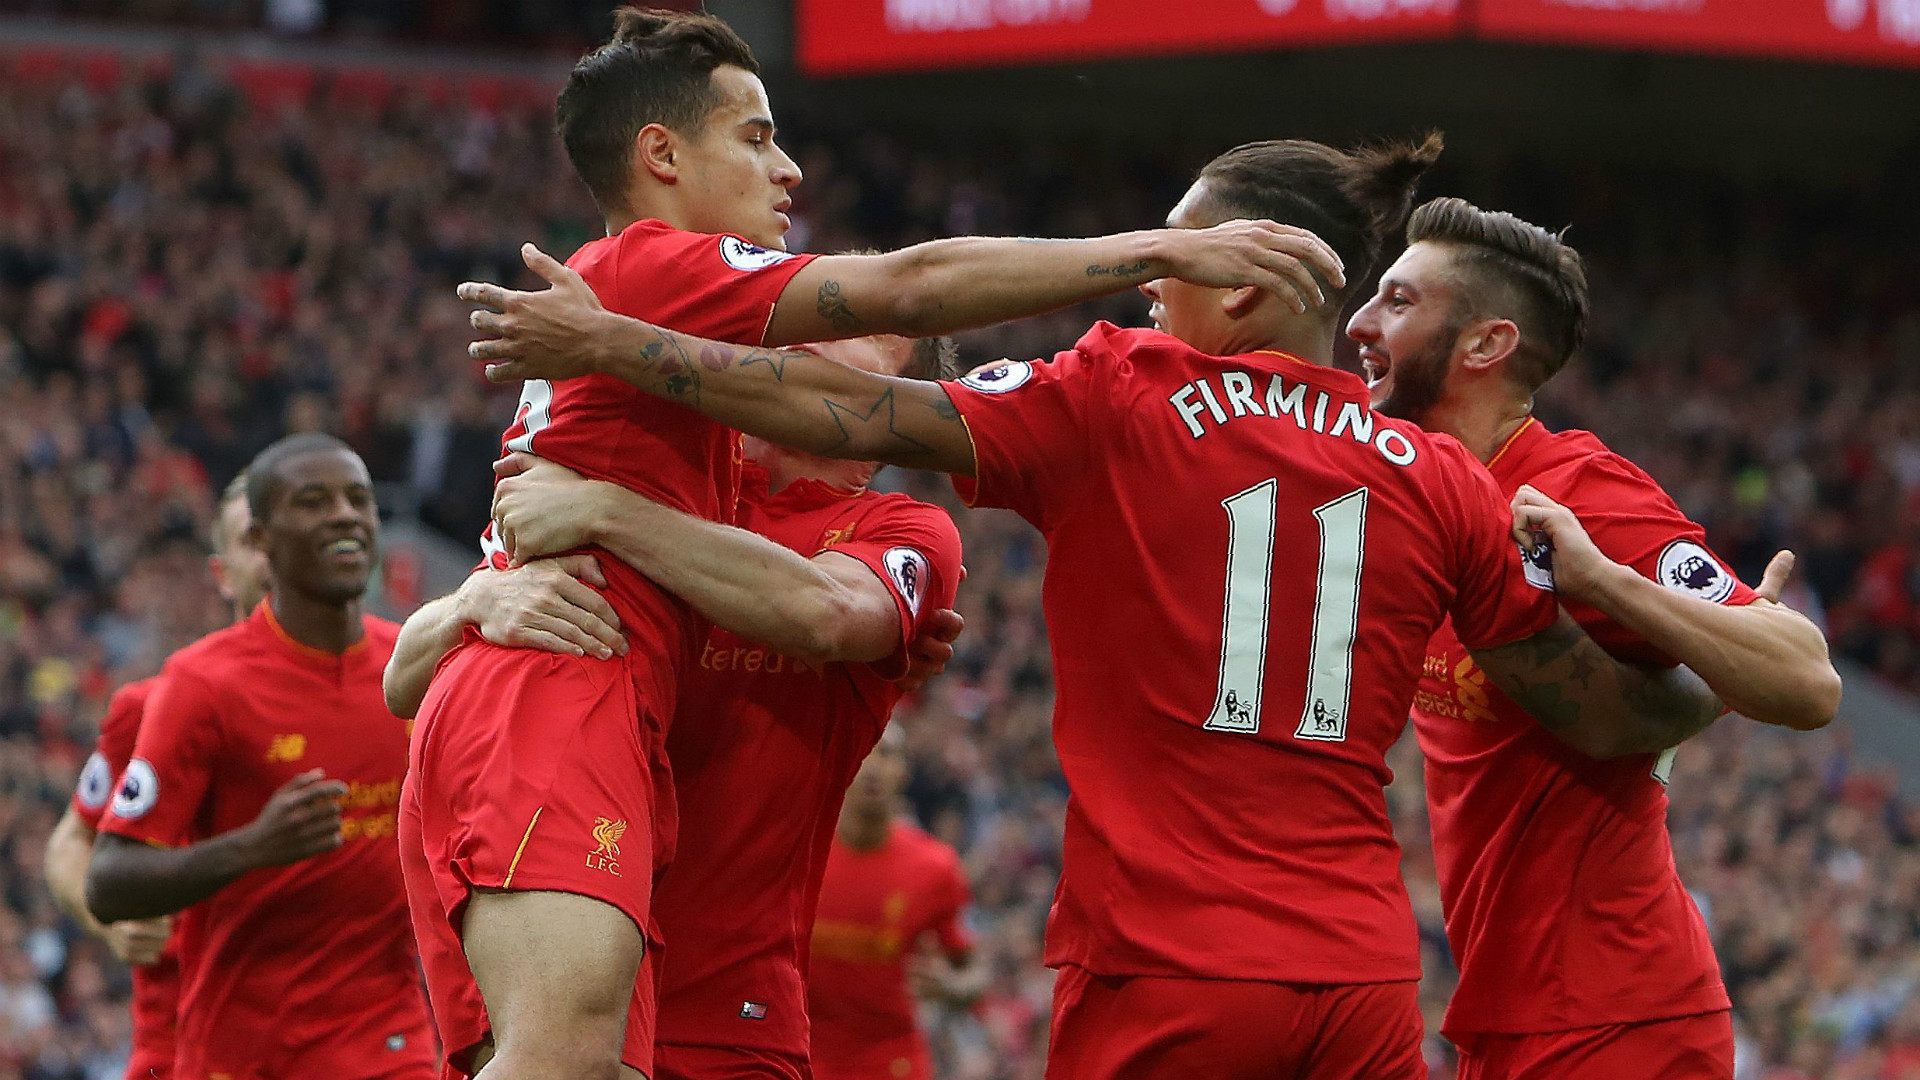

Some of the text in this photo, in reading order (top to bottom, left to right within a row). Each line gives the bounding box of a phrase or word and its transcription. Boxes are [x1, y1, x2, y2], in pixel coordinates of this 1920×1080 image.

[1169, 371, 1417, 466] FIRMINO
[1203, 478, 1369, 741] 11
[585, 854, 623, 878] L.F.C.
